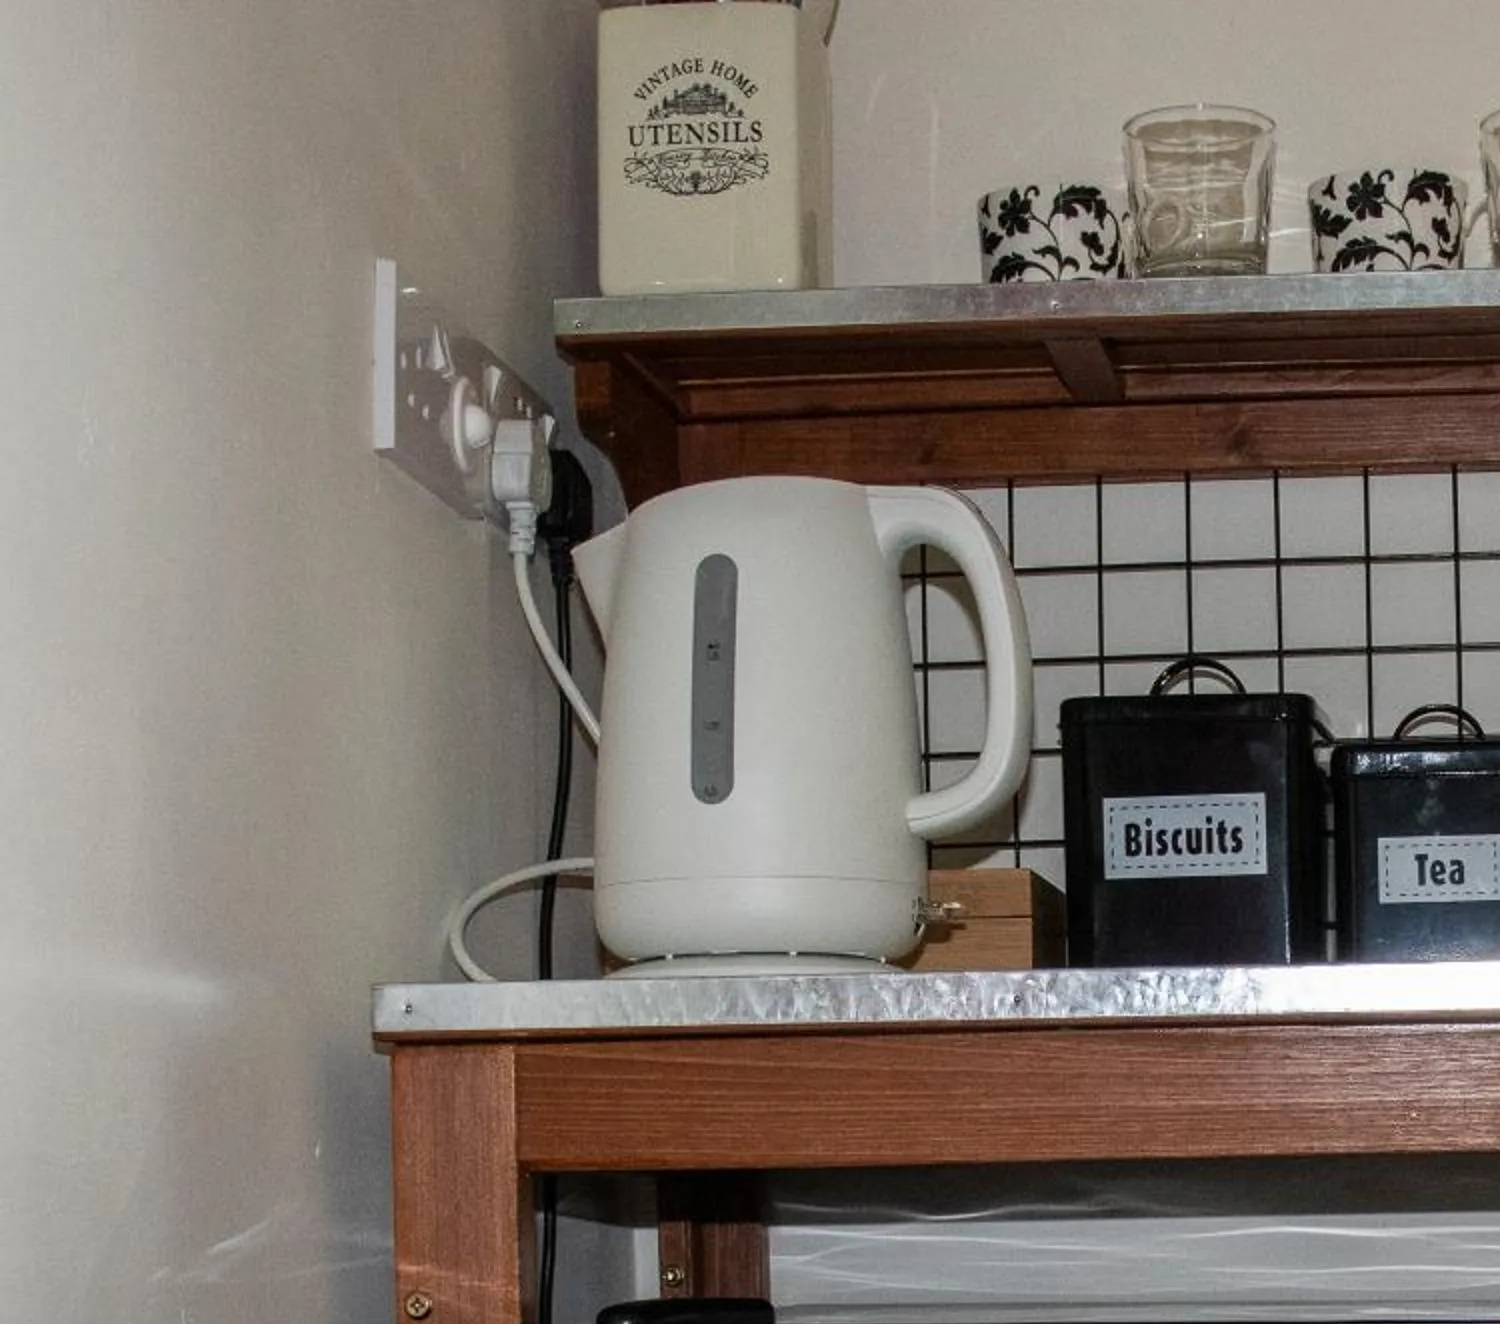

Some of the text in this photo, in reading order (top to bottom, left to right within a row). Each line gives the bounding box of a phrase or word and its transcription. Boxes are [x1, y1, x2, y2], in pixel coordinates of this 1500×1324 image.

[633, 58, 759, 101] VINTAGE HOME
[627, 121, 763, 147] UTENSILS
[1123, 815, 1244, 858] Biscuits
[1414, 853, 1466, 886] Tea
